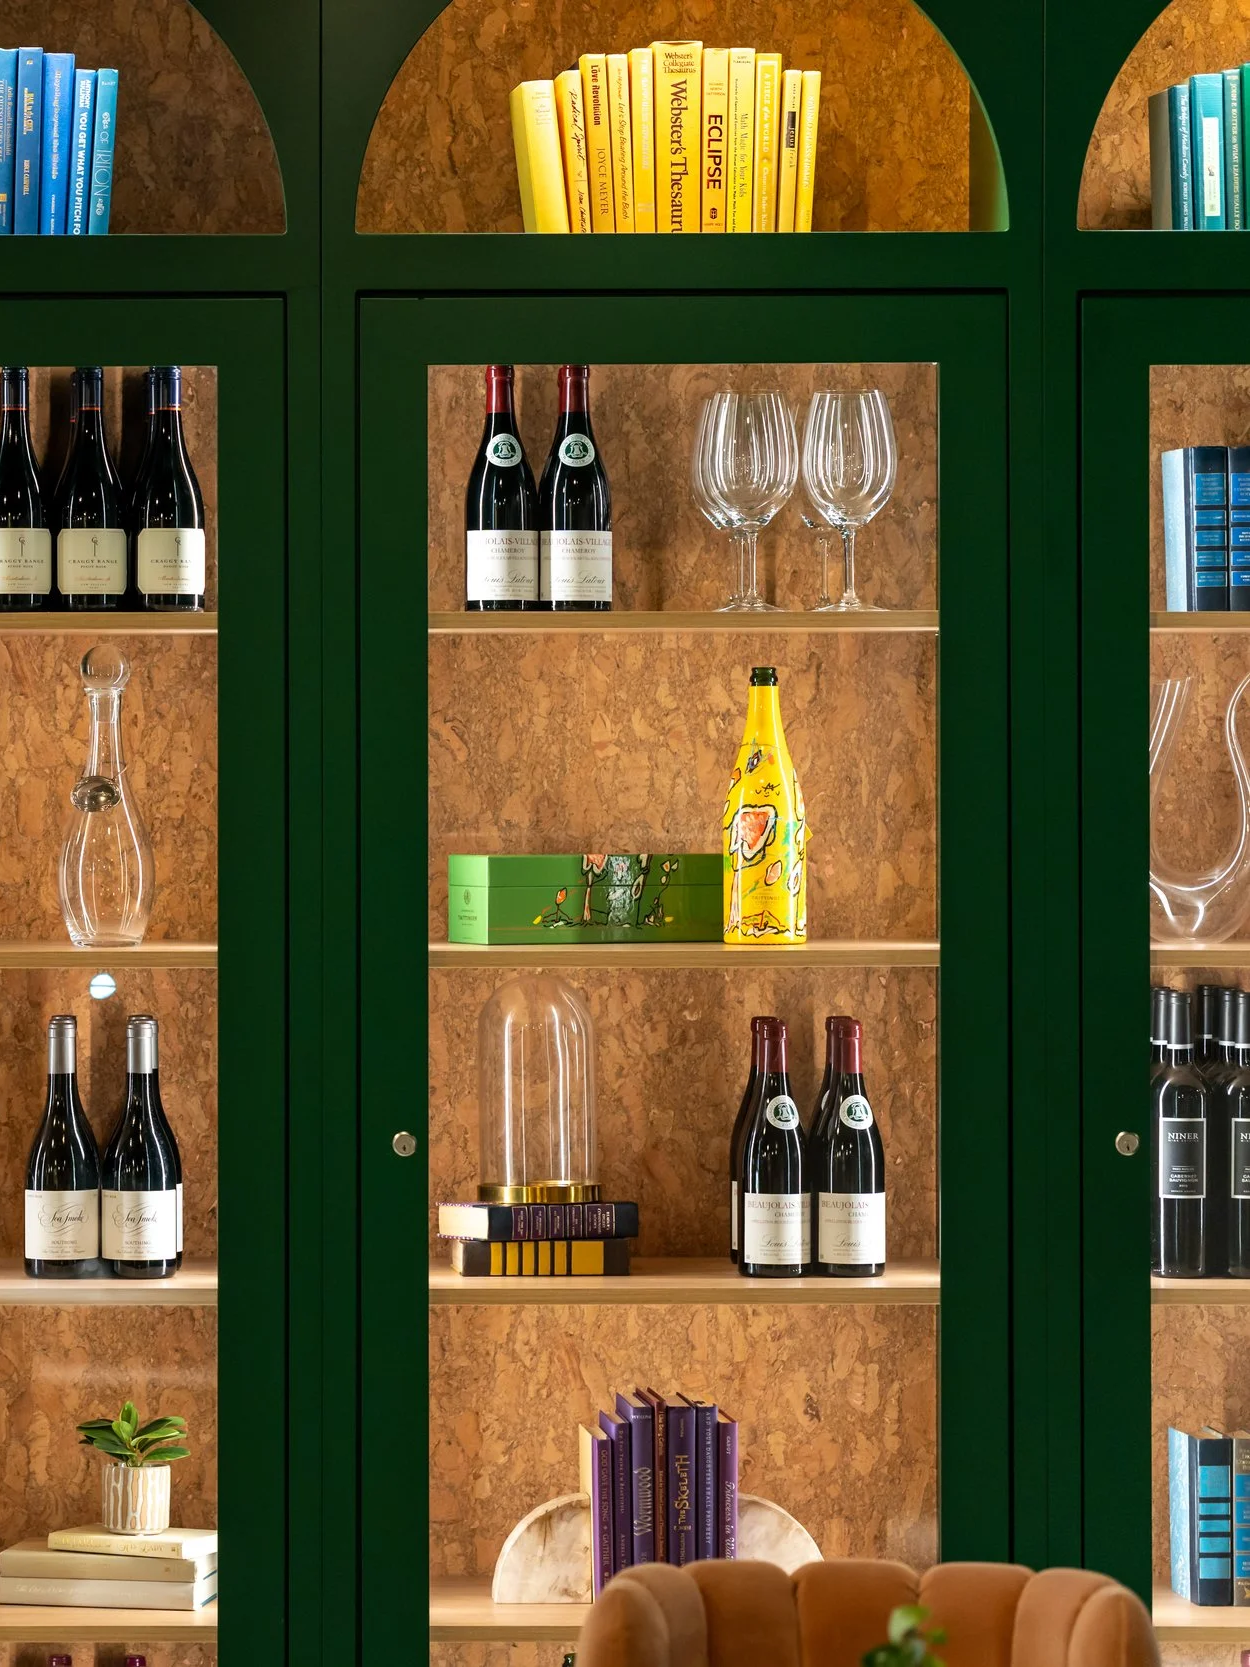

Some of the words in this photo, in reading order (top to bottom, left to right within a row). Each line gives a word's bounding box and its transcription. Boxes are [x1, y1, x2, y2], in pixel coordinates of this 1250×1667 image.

[590, 65, 599, 83] Love
[84, 79, 92, 109] ANTHONY
[1179, 94, 1188, 106] The
[568, 89, 583, 131] Radical
[592, 85, 601, 126] Revolution
[79, 111, 87, 131] YOU
[670, 79, 688, 155] Webster's
[618, 119, 627, 136] Stop
[78, 131, 86, 149] GET
[618, 136, 627, 163] Beating
[706, 114, 723, 190] ECLIPSE
[1230, 82, 1238, 101] JOHN
[1234, 219, 1240, 230] DO
[76, 150, 85, 176] WHAT
[596, 148, 607, 177] JOYCE
[94, 150, 112, 196] TRITON
[620, 164, 628, 190] Around
[75, 176, 84, 195] YOU
[599, 181, 609, 215] MEYER
[621, 190, 629, 201] the
[73, 196, 83, 222] PITCH
[622, 201, 630, 220] Bush
[507, 568, 534, 584] Latour
[576, 569, 606, 584] Latour
[1167, 1132, 1199, 1140] NINER
[50, 1210, 63, 1223] Sea
[64, 1210, 84, 1224] Smoke
[123, 1210, 136, 1223] Sea
[762, 1234, 788, 1248] Louis
[834, 1233, 861, 1248] Louis
[601, 1449, 609, 1467] GOD
[601, 1468, 609, 1486] GAVE
[674, 1454, 691, 1510] SKELETH
[601, 1487, 609, 1500] THE
[633, 1466, 652, 1536] Wormwood
[724, 1480, 736, 1522] Princess
[601, 1501, 609, 1522] SONG
[678, 1509, 686, 1524] THE
[724, 1525, 736, 1535] in
[601, 1534, 609, 1566] GAITHER
